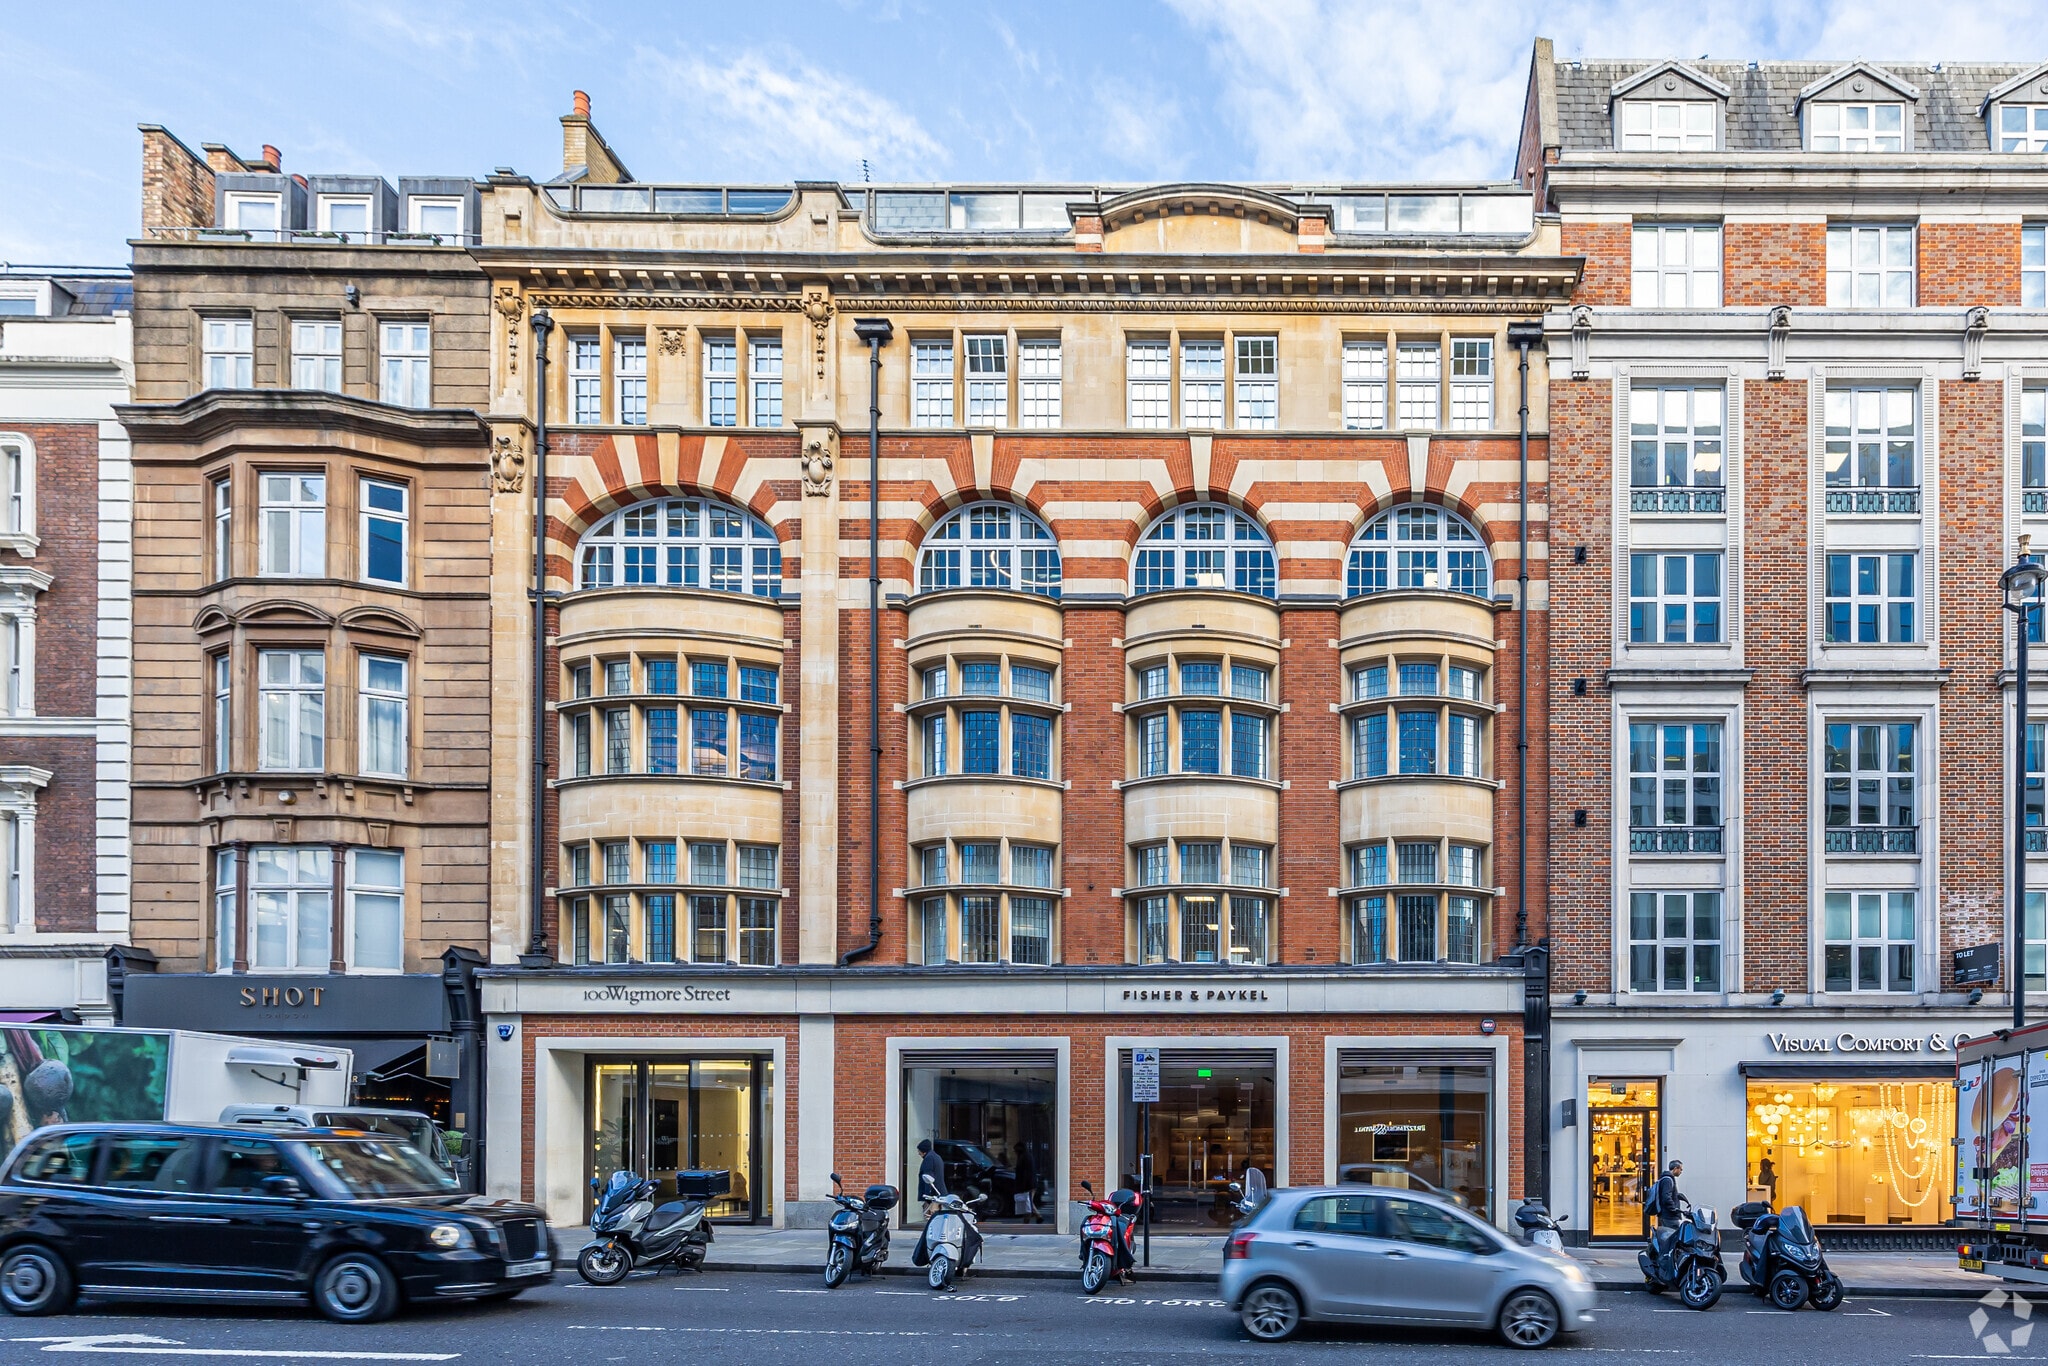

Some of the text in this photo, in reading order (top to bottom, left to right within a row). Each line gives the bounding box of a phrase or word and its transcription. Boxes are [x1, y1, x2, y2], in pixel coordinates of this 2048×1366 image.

[240, 986, 326, 1006] SHOT
[684, 985, 730, 1001] Street
[1123, 990, 1269, 1001] FISHER & PAYKEL
[257, 1012, 309, 1020] LONDON
[1929, 1033, 1951, 1051] &
[931, 1294, 1228, 1307] SOLO MOTORC
